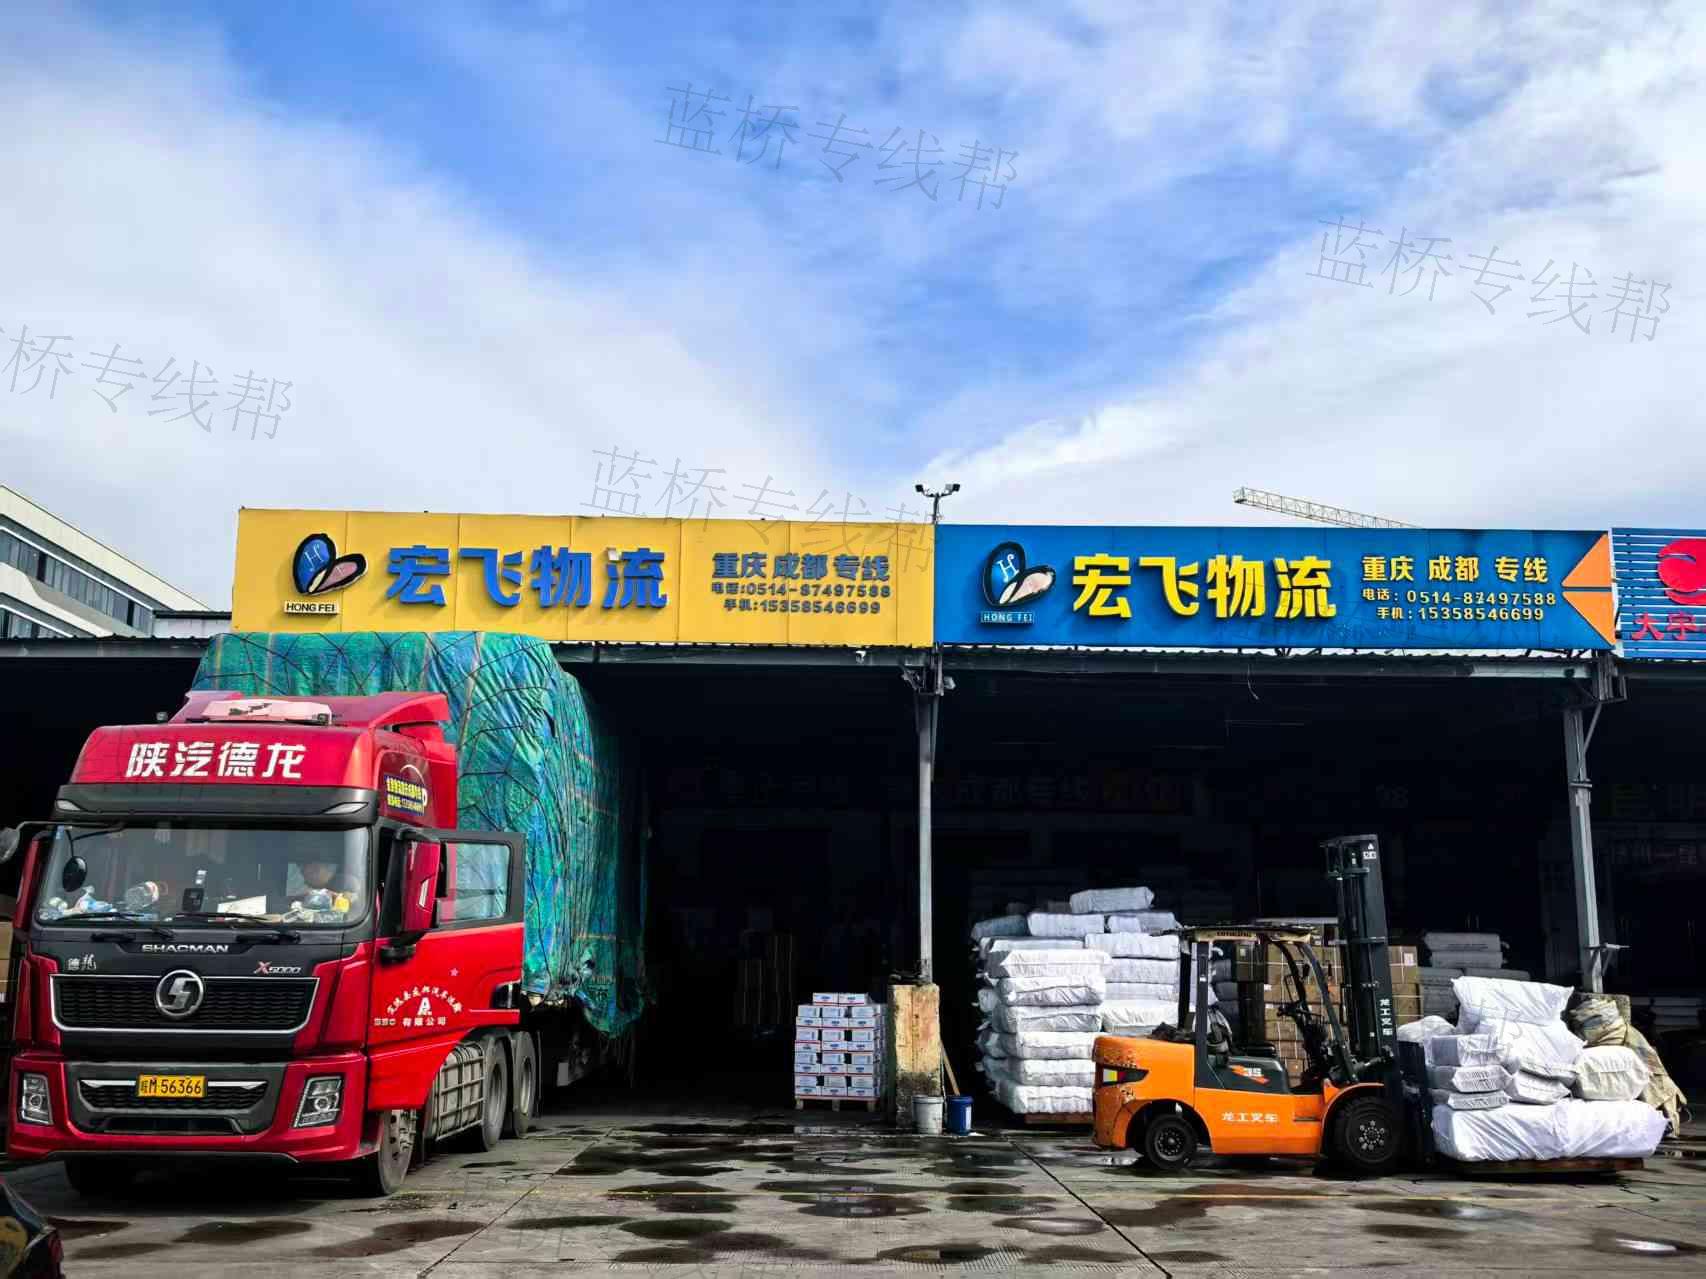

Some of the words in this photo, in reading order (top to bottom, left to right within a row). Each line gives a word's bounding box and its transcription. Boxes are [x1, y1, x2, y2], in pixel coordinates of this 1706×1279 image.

[386, 545, 667, 609] 宏飞物流
[712, 552, 768, 579] 重庆
[772, 553, 828, 580] 成都
[834, 555, 891, 581] 专线
[1362, 556, 1415, 582] 重庆
[1428, 555, 1480, 582] 成都
[1495, 556, 1549, 583] 专线
[1072, 552, 1337, 618] 宏飞物流
[286, 602, 316, 612] HONG
[318, 603, 335, 612] FEI
[983, 612, 1013, 622] HONG
[126, 741, 306, 779] 陕汽德龙
[142, 943, 229, 953] SHACMAN
[1221, 1111, 1280, 1124] 龙工叉车
